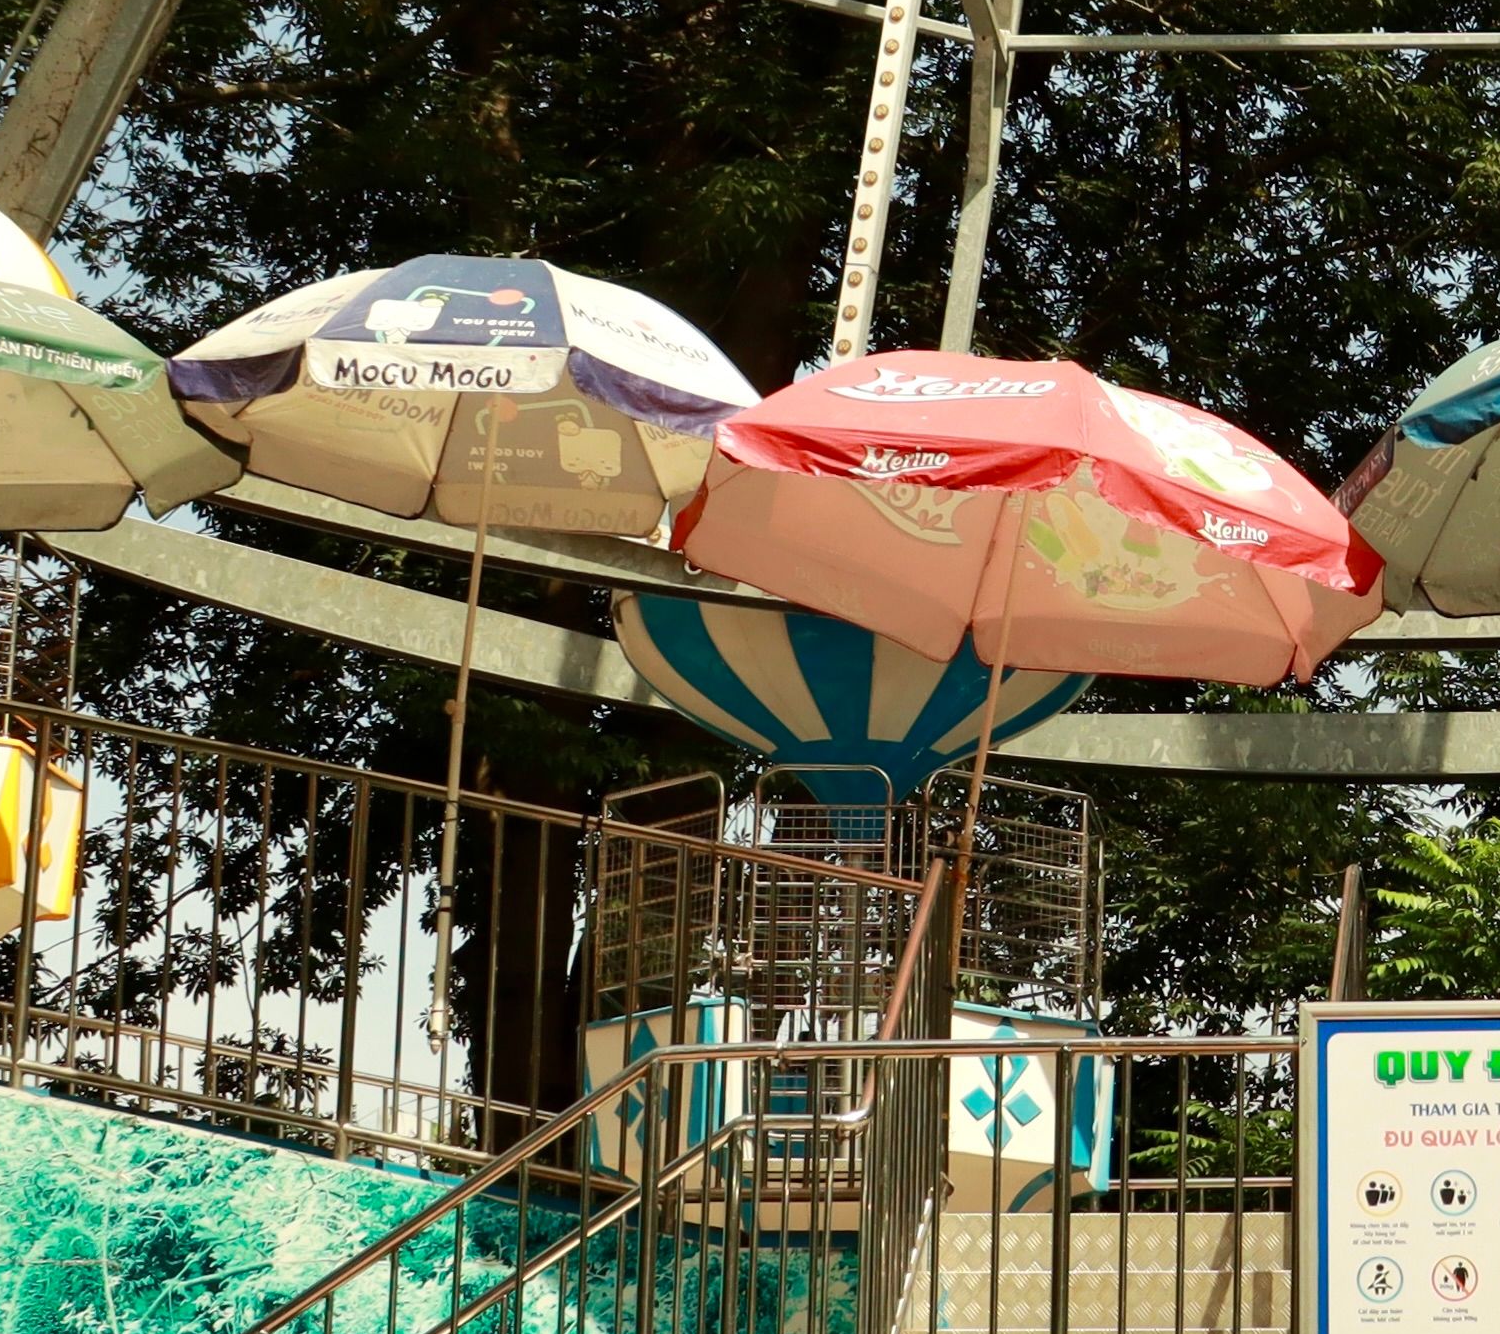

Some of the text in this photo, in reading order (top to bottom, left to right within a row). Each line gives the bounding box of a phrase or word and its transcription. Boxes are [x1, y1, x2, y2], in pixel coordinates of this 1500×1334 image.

[452, 317, 535, 329] YOU GOTTA
[489, 328, 535, 338] CHEW!
[333, 357, 512, 390] MOGU MOGU
[826, 366, 1057, 403] Merino
[849, 444, 950, 478] Merino
[1196, 511, 1269, 547] Merino
[1374, 1049, 1473, 1088] QUY
[1410, 1104, 1457, 1116] THAM
[1462, 1103, 1490, 1116] GIA
[1384, 1130, 1414, 1147] ĐU
[1421, 1129, 1479, 1147] QUAY
